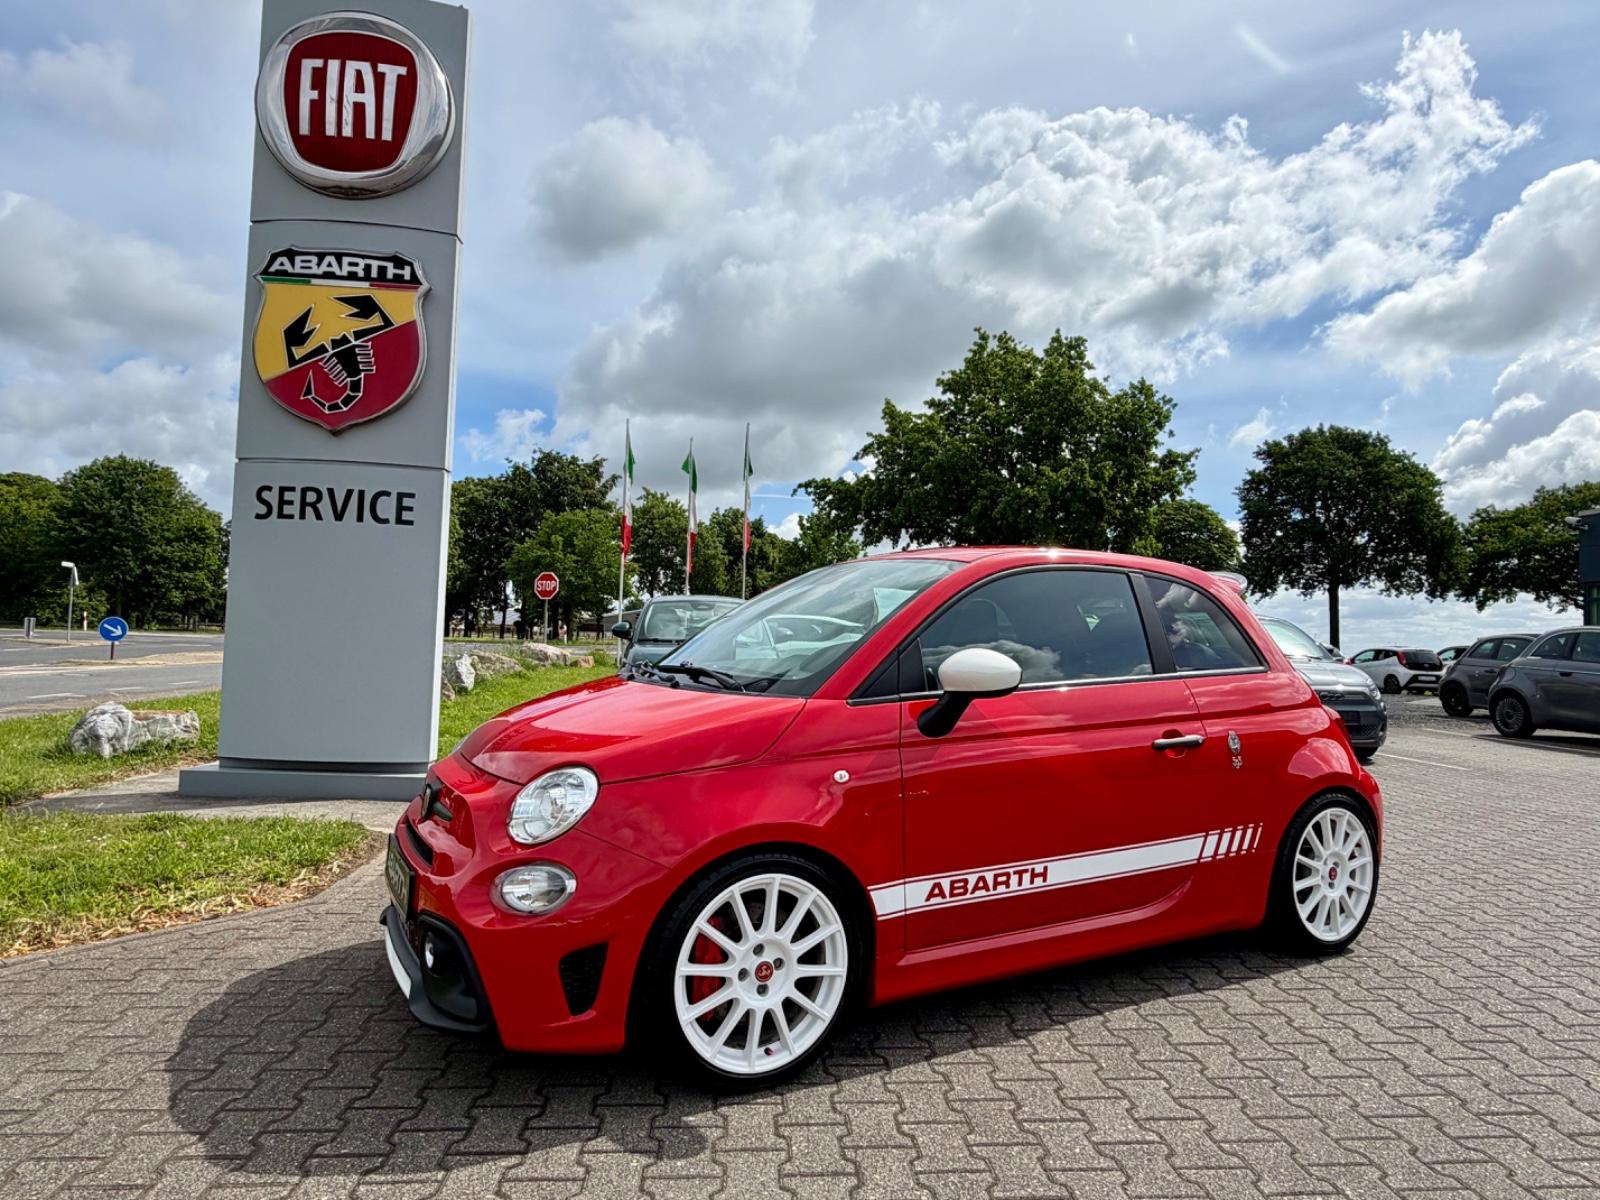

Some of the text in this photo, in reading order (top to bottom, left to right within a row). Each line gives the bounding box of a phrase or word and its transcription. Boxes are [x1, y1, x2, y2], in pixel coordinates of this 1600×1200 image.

[299, 58, 408, 141] FIAT
[269, 255, 411, 281] ABARTH
[254, 485, 416, 525] SERVICE
[537, 580, 556, 591] STOP
[925, 865, 1048, 902] ABARTH
